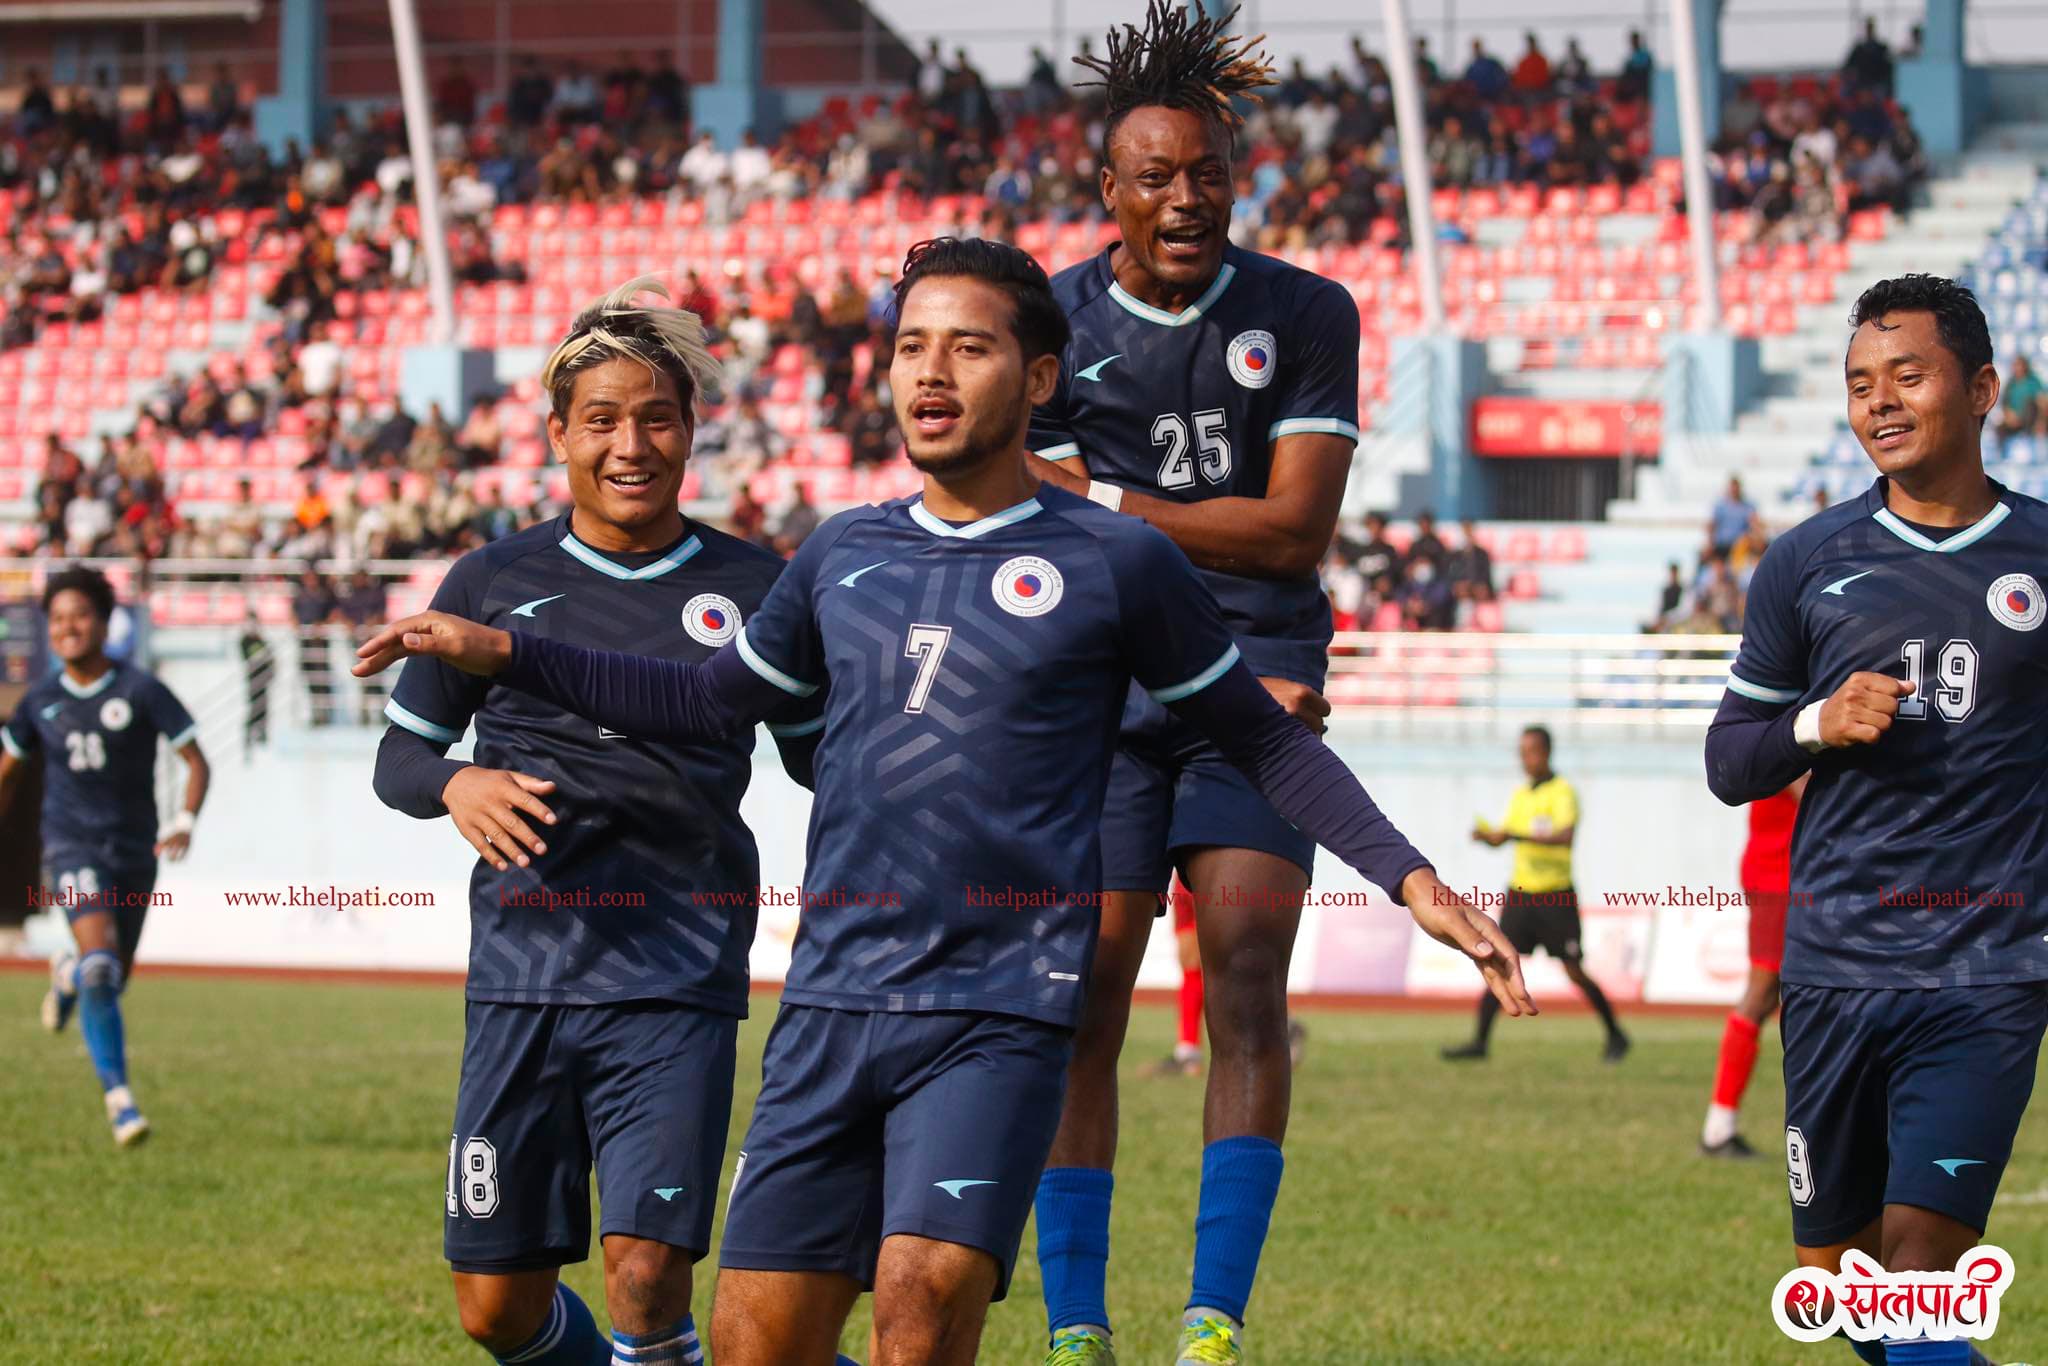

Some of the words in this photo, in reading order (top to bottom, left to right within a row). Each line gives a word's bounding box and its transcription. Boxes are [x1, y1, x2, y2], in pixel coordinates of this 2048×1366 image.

[1150, 407, 1232, 491] 25
[903, 623, 952, 714] 7
[1896, 638, 1980, 723] 19
